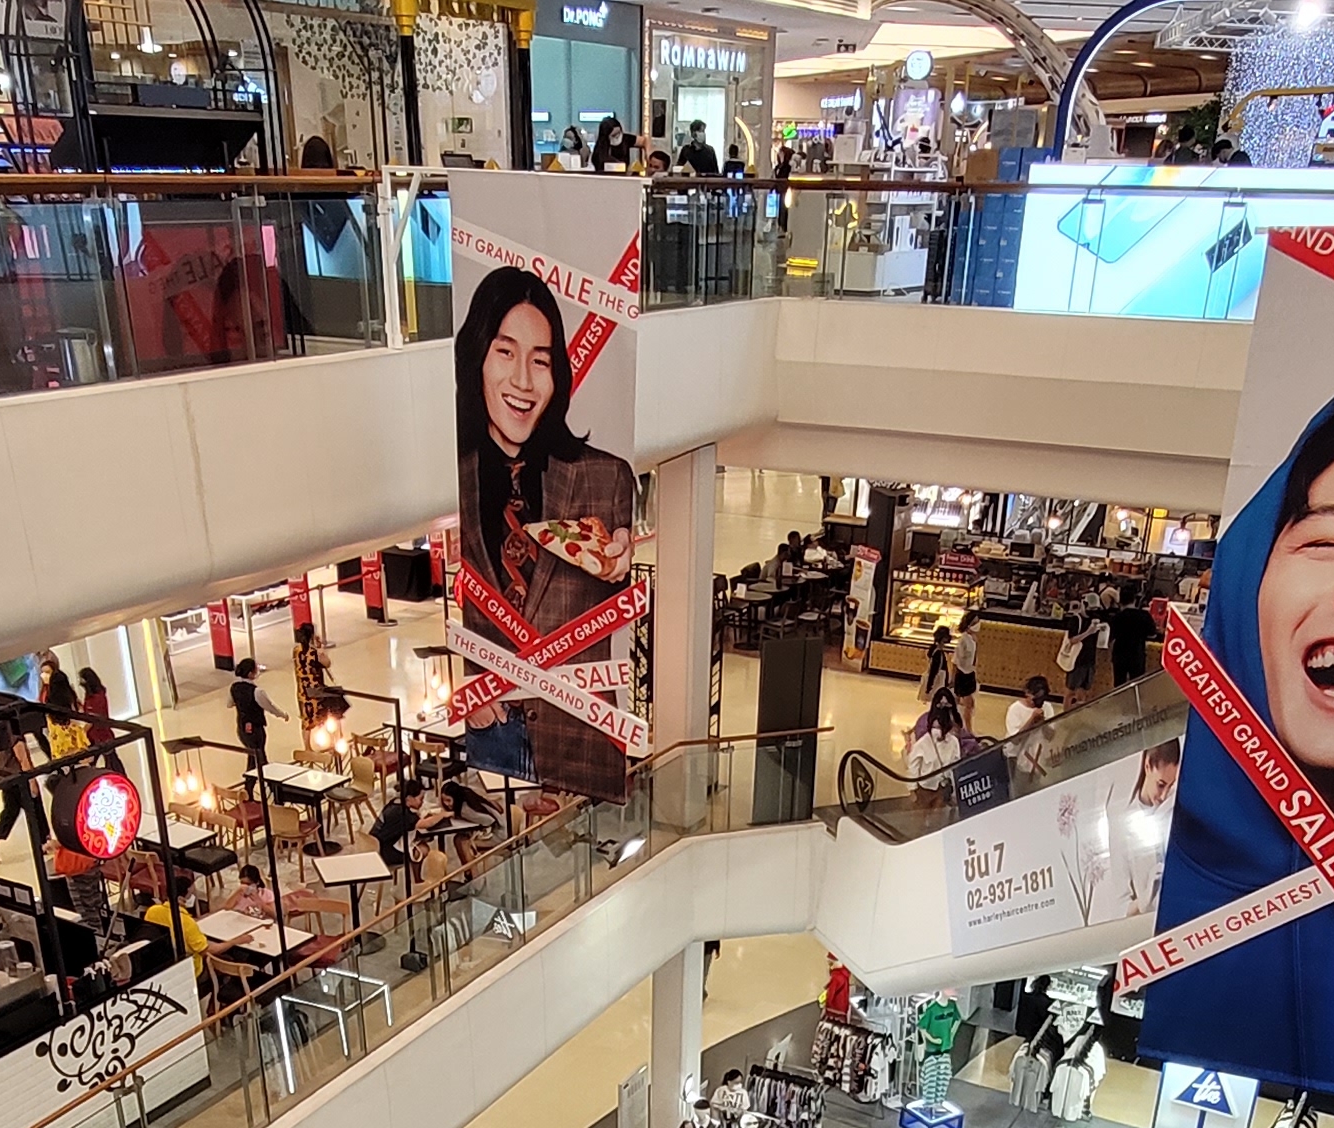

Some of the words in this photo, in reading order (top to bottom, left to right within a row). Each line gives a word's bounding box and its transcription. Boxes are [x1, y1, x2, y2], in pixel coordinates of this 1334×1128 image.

[563, 5, 604, 28] Dr.PONG
[475, 238, 526, 270] GRAND
[531, 256, 594, 306] SALE
[598, 289, 625, 314] THE
[487, 600, 530, 644] GRAND
[574, 608, 618, 642] GRAND
[452, 674, 502, 718] SALE
[454, 632, 476, 654] THE
[478, 648, 538, 686] GREATEST
[539, 679, 585, 711] GRAND
[587, 702, 644, 748] SALE
[574, 663, 630, 690] SALE
[1167, 636, 1242, 724] GREATEST
[1233, 723, 1290, 791] GRAND
[993, 842, 1006, 874] 7
[966, 866, 1055, 911] 02-937-1811
[1112, 937, 1186, 993] ALE
[1183, 922, 1223, 952] THE
[1225, 878, 1324, 933] GREATEST
